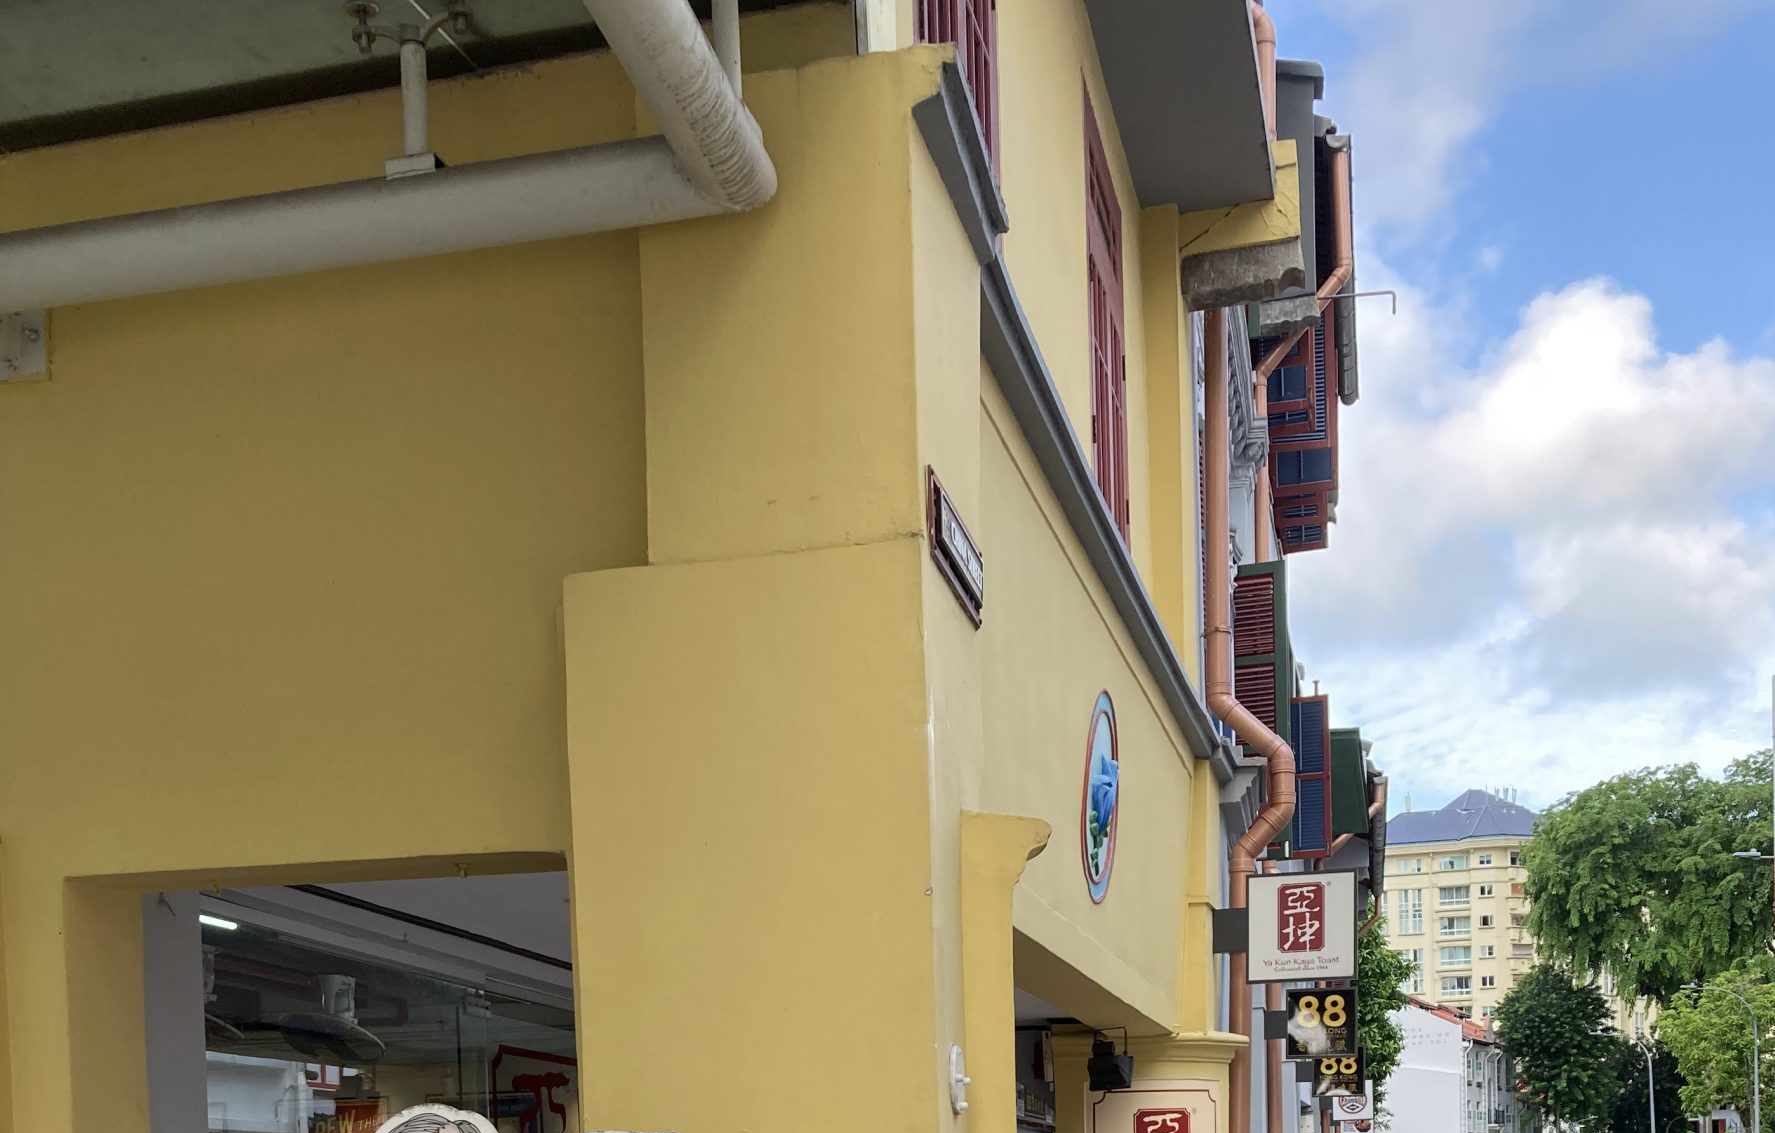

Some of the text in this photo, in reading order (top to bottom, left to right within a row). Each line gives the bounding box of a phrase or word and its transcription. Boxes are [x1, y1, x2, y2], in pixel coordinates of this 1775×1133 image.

[1262, 959, 1273, 967] Ya
[1294, 958, 1315, 966] Kaya
[1316, 956, 1340, 964] Toast
[1297, 994, 1347, 1028] 88
